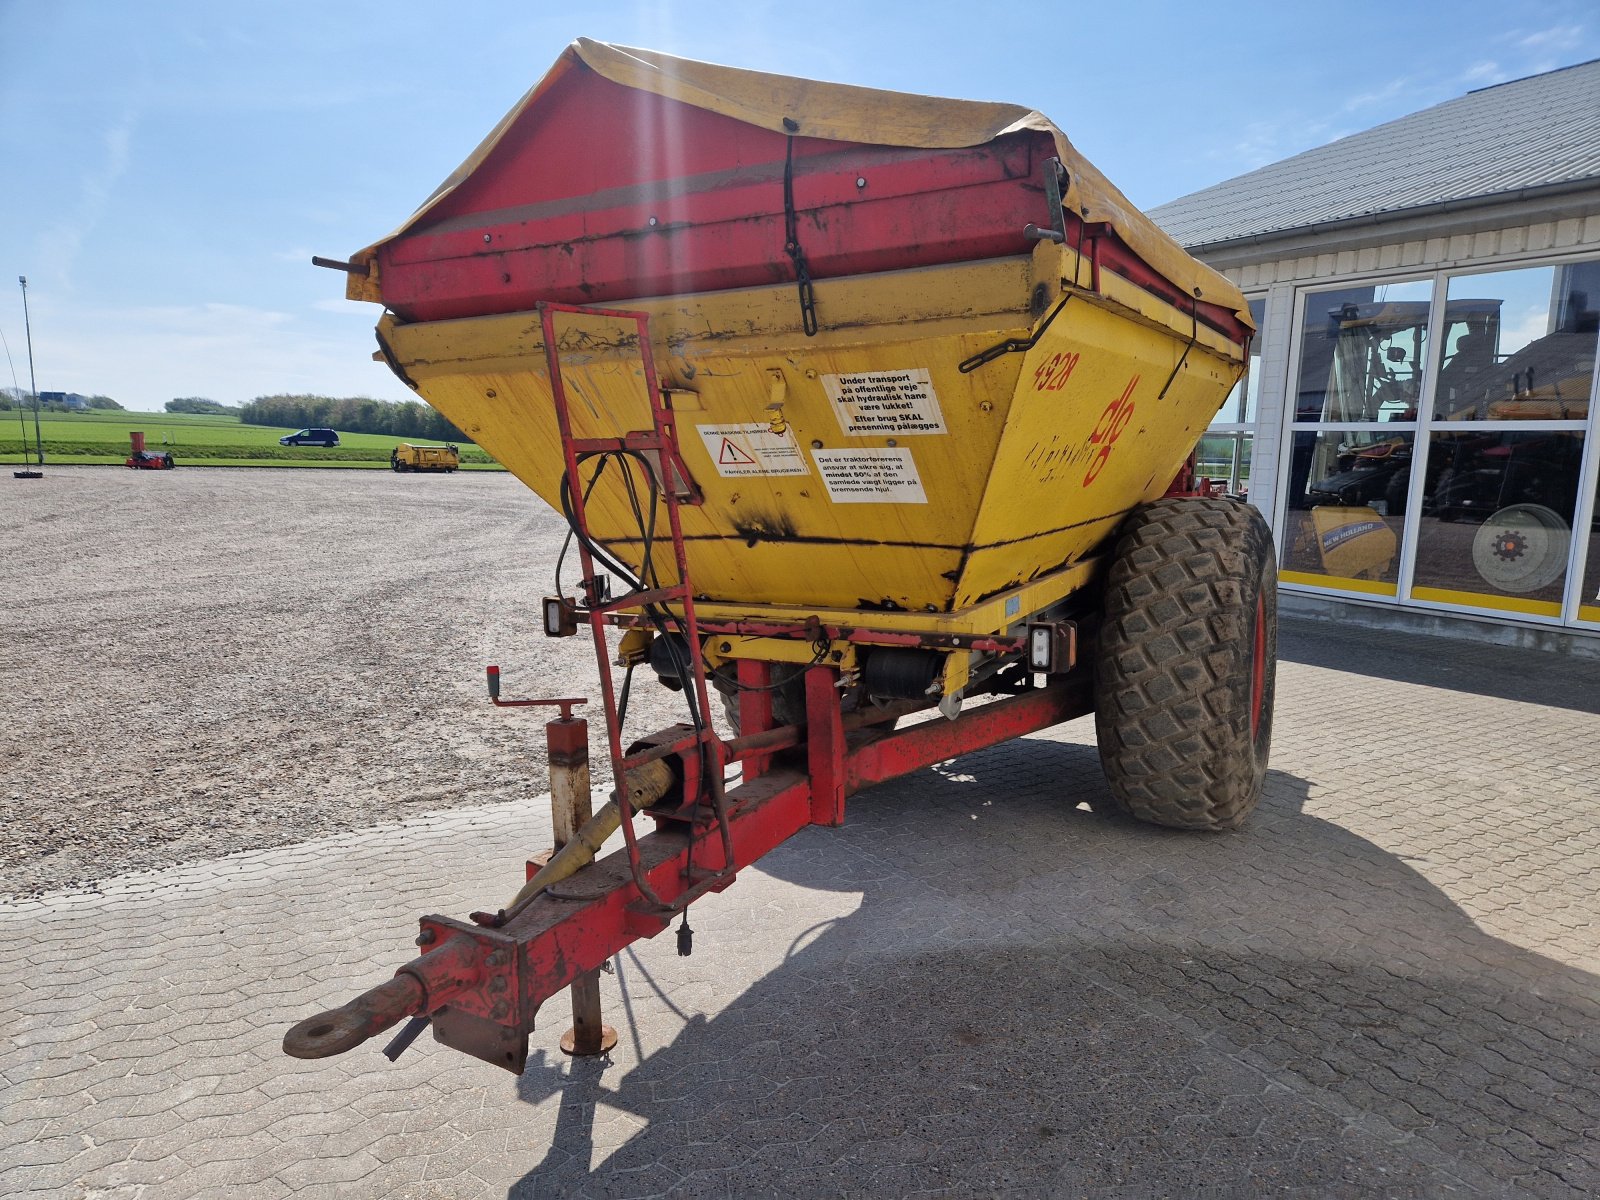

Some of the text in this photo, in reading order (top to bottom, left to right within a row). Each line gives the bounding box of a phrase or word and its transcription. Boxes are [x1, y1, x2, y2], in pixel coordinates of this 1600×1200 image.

[1032, 352, 1080, 391] 4928
[839, 374, 911, 386] Under transport
[841, 383, 918, 395] på offentlige veje
[837, 393, 927, 404] skal hydraulisk hane
[882, 402, 913, 410] lukket!
[854, 413, 924, 423] Efter brug SKAL
[848, 421, 940, 433] presenning pålægges
[907, 478, 917, 486] på
[875, 486, 892, 494] hjul.
[1340, 523, 1374, 539] HOLLAND
